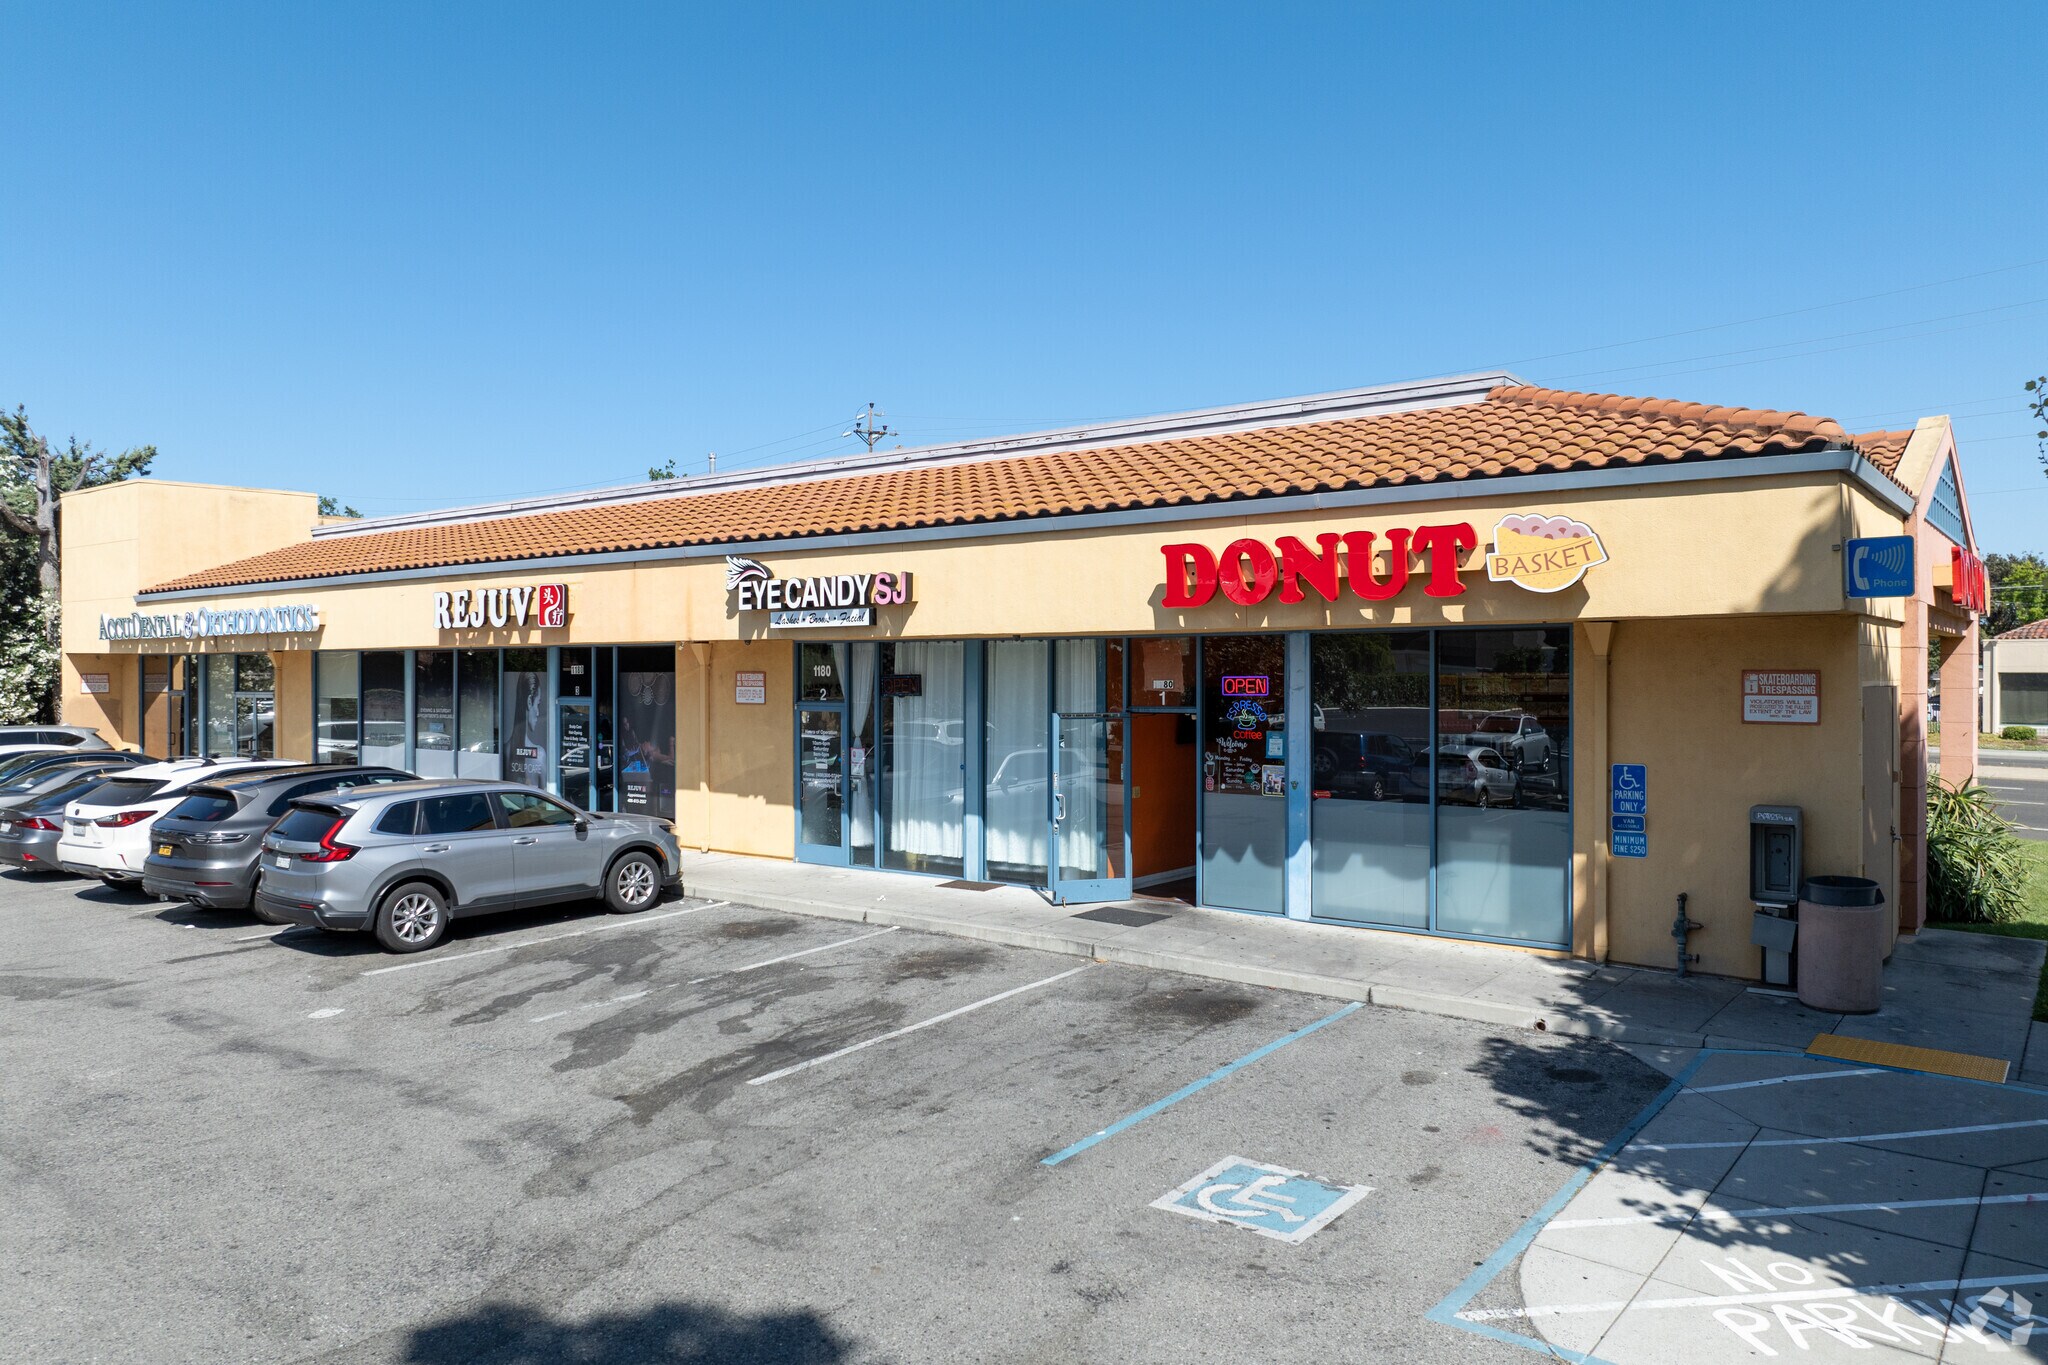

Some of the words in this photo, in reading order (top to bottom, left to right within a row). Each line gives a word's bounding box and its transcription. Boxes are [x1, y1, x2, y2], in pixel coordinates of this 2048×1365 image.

[1495, 540, 1593, 577] BASKET
[1160, 522, 1477, 609] DONUT
[1873, 578, 1908, 588] Phone
[738, 579, 782, 611] EYE
[784, 573, 872, 609] CANDY
[874, 571, 907, 606] SJ
[433, 586, 534, 629] REJUV
[183, 611, 197, 639] &
[197, 604, 315, 638] ORTHODONTICS
[774, 613, 800, 626] Lashes
[808, 612, 831, 624] Brows
[839, 612, 866, 626] Facial
[813, 664, 832, 677] 1180
[1163, 680, 1174, 689] 80
[1224, 678, 1266, 694] OPEN
[1758, 673, 1817, 686] SKATEBOARDING
[819, 688, 827, 701] 2
[1761, 685, 1816, 695] TRESPASSING
[1158, 691, 1166, 706] 1
[1226, 699, 1268, 722] ESPRESSO
[1233, 730, 1263, 740] Coffee
[516, 748, 532, 756] REJUV
[1614, 789, 1644, 801] PARKING
[1620, 801, 1639, 812] ONLY
[1614, 835, 1645, 845] MINIMUM
[1613, 844, 1628, 854] FINE
[1629, 845, 1646, 855] $250
[1699, 1256, 1816, 1293] NO
